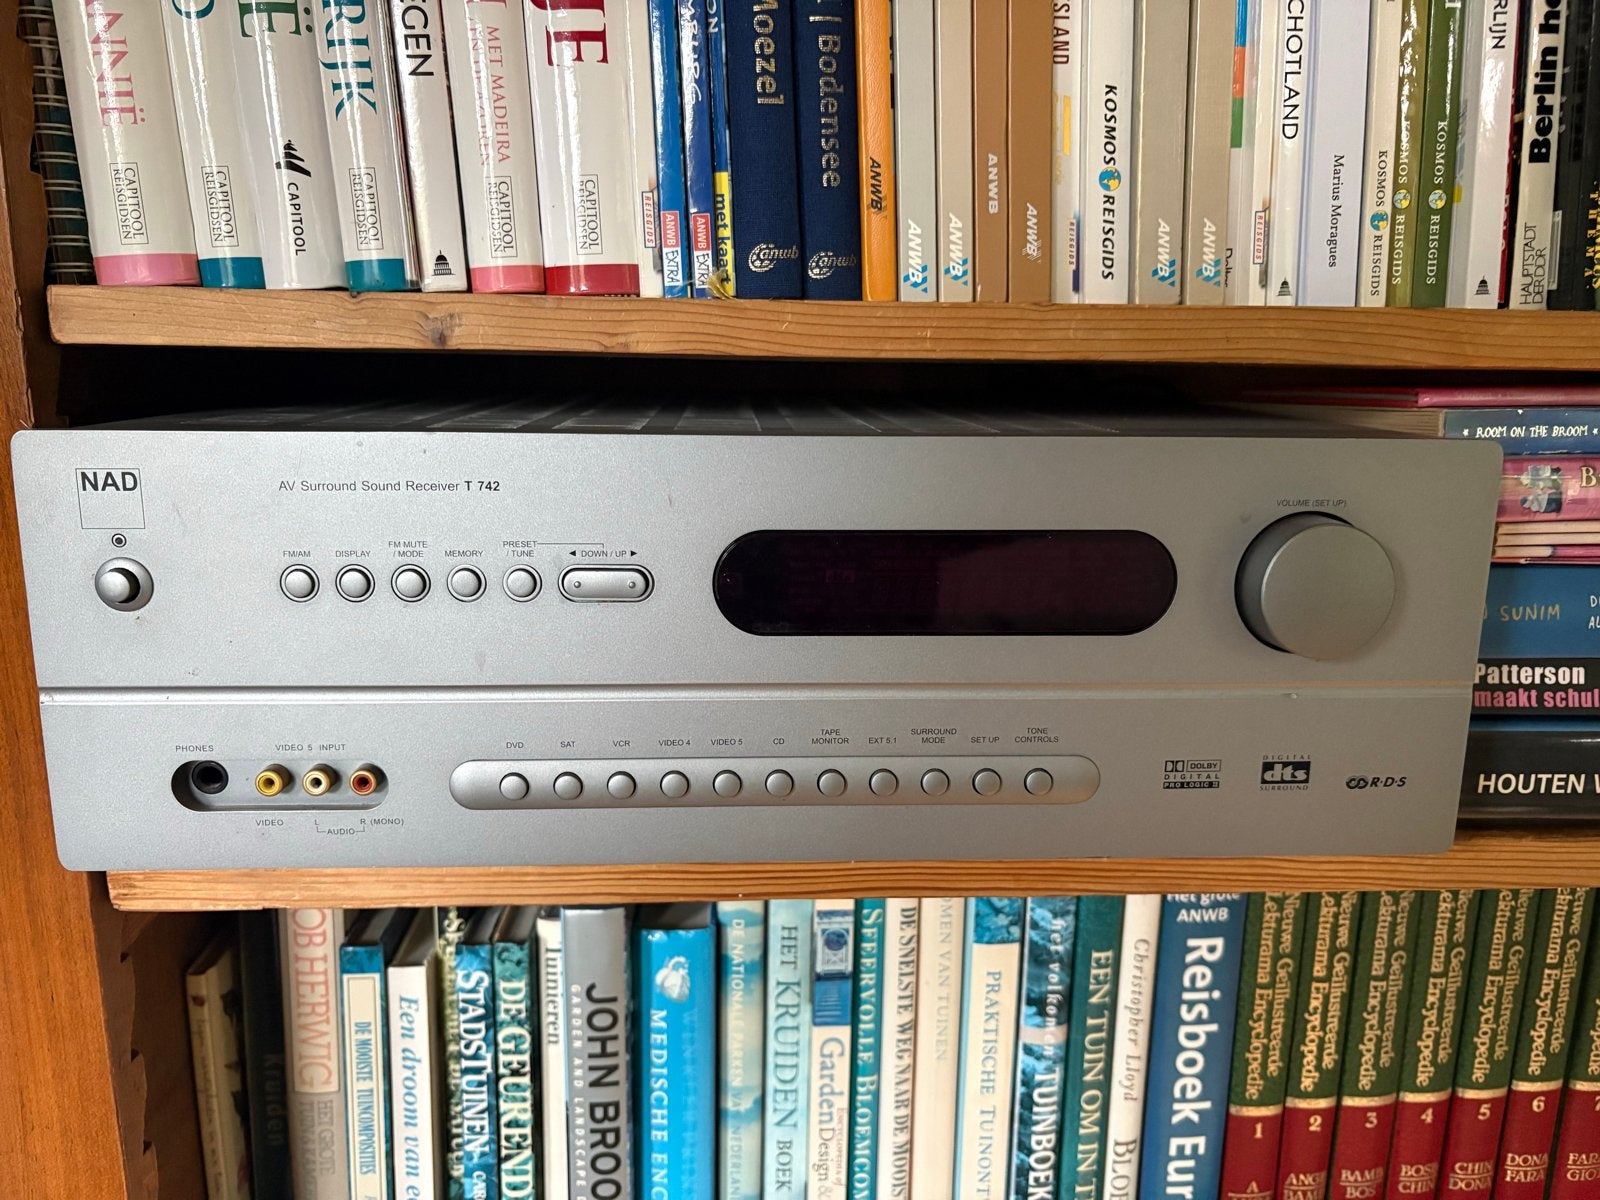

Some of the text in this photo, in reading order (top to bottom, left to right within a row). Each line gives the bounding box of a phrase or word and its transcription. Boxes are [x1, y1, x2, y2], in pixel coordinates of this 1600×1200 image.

[486, 25, 512, 164] MET MADEIRA
[817, 34, 844, 188] Bodensee
[1528, 46, 1561, 163] Berlin
[112, 168, 134, 241] REISGIDSEN
[123, 167, 145, 240] CAPITOOL
[868, 156, 883, 212] ANWB
[987, 152, 999, 215] ANWB
[1101, 83, 1118, 281] KOSMOS REISGIDS
[1391, 120, 1411, 286] KOSMOS REISGIDS
[1425, 120, 1448, 285] KOSMOS REISGIDS
[204, 171, 224, 243] REISGIDSEN
[215, 170, 236, 242] CAPITOOL
[287, 182, 307, 256] CAPITOOL
[352, 173, 370, 246] REISGIDSEN
[362, 171, 380, 244] CAPITOOL
[498, 180, 514, 252] CAPITOOL
[585, 178, 600, 250] CAPITOOL
[644, 195, 654, 246] REISGIDS
[714, 193, 728, 231] met
[1326, 154, 1345, 268] Marius Moragues
[1370, 150, 1389, 297] KOSMOS REISGIDS
[665, 214, 680, 285] ANWB EXTRA
[695, 216, 709, 288] ANWB EXTRA
[906, 218, 922, 285] ANWB
[949, 212, 964, 278] ANWB
[1025, 202, 1039, 257] ANWB
[1067, 221, 1076, 267] REISGIDS
[1156, 218, 1171, 278] ANWB
[1202, 217, 1217, 277] ANWB
[1255, 214, 1264, 262] REISGIDS
[1519, 222, 1537, 305] HAUPTSTADT
[1532, 246, 1548, 305] DER DDR
[1475, 425, 1589, 438] ROOM ON THE BROOM
[80, 471, 139, 492] NAD
[279, 480, 501, 492] AV Surround Sound Receiver T 742
[1276, 499, 1310, 507] VOLUME
[282, 550, 311, 558] FM/AM
[335, 550, 371, 558] DISPLAY
[388, 540, 428, 548] FM MUTE
[397, 550, 424, 558] MODE
[444, 550, 484, 558] MEMORY
[502, 540, 538, 548] PRESET
[511, 549, 535, 558] TUNE
[580, 549, 627, 558] DOWN UP
[1500, 603, 1561, 622] SUNIM
[1474, 663, 1586, 685] Patterson
[1473, 688, 1539, 708] maakt
[175, 744, 214, 753] PHONES
[275, 743, 346, 752] VIDEO 5 INPUT
[505, 741, 525, 749] DVD
[560, 740, 576, 748] SAT
[612, 740, 631, 748] VCR
[658, 739, 692, 747] VIDEO 4
[710, 738, 743, 746] VIDEO 5
[772, 737, 785, 745] CD
[811, 737, 850, 745] MONITOR
[820, 728, 841, 736] TAPE
[868, 737, 898, 745] EXT 5.1
[910, 728, 957, 736] SURROUND
[921, 736, 946, 744] MODE
[970, 736, 1000, 744] SET UP
[1014, 735, 1059, 744] CONTROLS
[1026, 727, 1049, 735] TONE
[1163, 772, 1220, 780] DIGITAL
[1189, 762, 1218, 770] DOLBY
[1262, 753, 1312, 761] DIGITAL
[1263, 762, 1309, 783] dts
[1163, 781, 1210, 789] PRO LOGIC
[1259, 784, 1309, 792] SURROUND
[1477, 773, 1586, 795] HOUTEN
[255, 818, 284, 827] VIDEO
[326, 827, 356, 836] AUDIO
[370, 817, 405, 826] (MONO)
[731, 918, 745, 938] DE
[1176, 907, 1229, 922] ANWB
[498, 980, 527, 1019] DE
[729, 943, 745, 1027] NATIONALE
[857, 908, 884, 1065] SFEERVOLLE
[1044, 918, 1067, 1057] het volkomen
[1088, 949, 1115, 1005] EEN
[294, 954, 333, 1088] HERWIG
[399, 995, 420, 1039] Een
[892, 906, 917, 1138] DE SNELSTE WEG NAAR DE
[936, 950, 952, 1062] VAN TUINEN
[1118, 938, 1150, 1103] Christopher Lloyd
[1527, 967, 1561, 1077] Encyclopedie
[585, 982, 620, 1088] JOHN
[979, 970, 1002, 1096] PRAKTISCHE
[1082, 1012, 1109, 1083] TUIN
[1171, 936, 1225, 1125] Reisboek
[1245, 988, 1273, 1100] Encyclopedie
[1300, 981, 1330, 1093] Encyclopedie
[1358, 980, 1387, 1091] Encyclopedie
[1416, 976, 1447, 1088] Encyclopedie
[1472, 975, 1505, 1084] Encyclopedie
[649, 1008, 669, 1143] MEDISCHE
[772, 925, 802, 1193] HET KRUIDEN BOEK
[354, 1021, 377, 1175] DE MOOISTE TUINCOMPOSITIES
[401, 1047, 422, 1127] droom
[570, 984, 588, 1188] GARDEN AND LANDSCAPE
[813, 1036, 848, 1182] Garden Design
[1532, 1096, 1546, 1113] 6
[1078, 1089, 1104, 1137] OM
[1253, 1121, 1264, 1139] 1
[1308, 1115, 1323, 1132] 2
[1364, 1111, 1378, 1129] 3
[1420, 1107, 1434, 1124] 4
[1477, 1103, 1492, 1121] 5
[403, 1133, 421, 1177] van
[1076, 1140, 1099, 1173] IN
[1246, 1180, 1259, 1193] A
